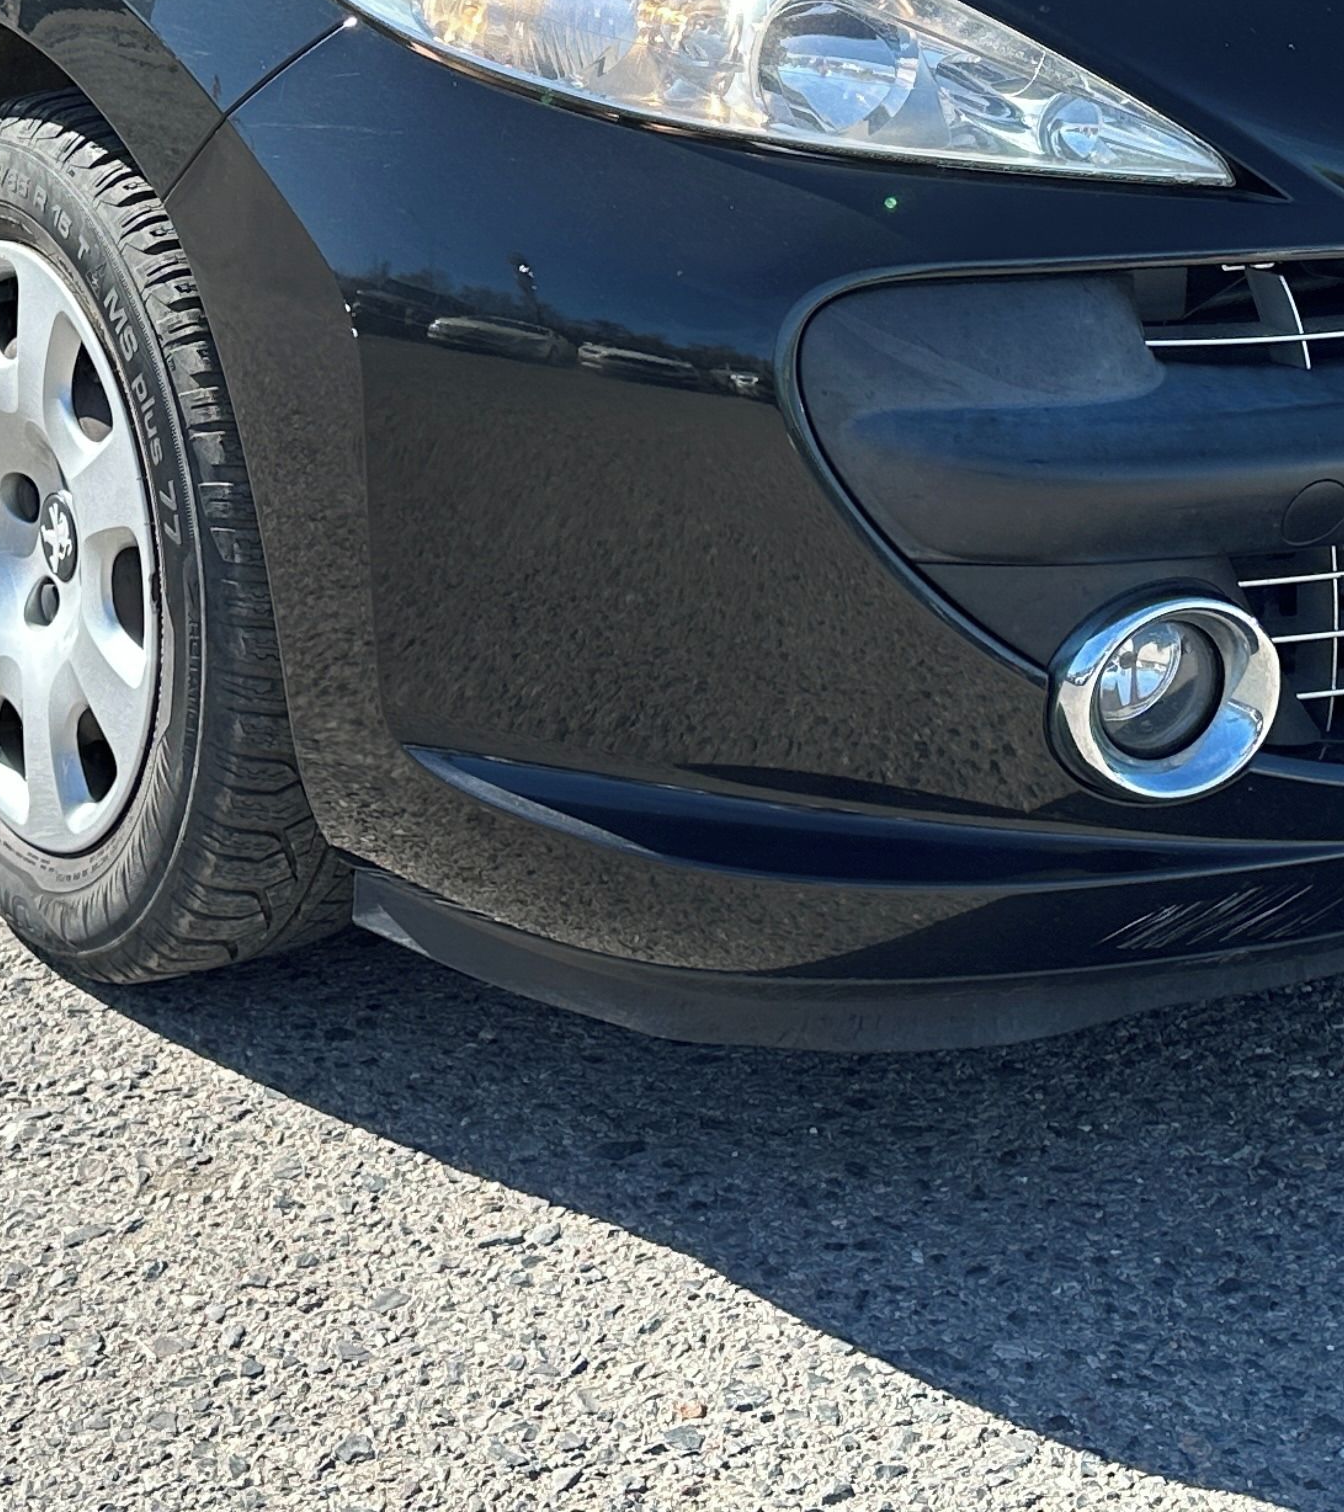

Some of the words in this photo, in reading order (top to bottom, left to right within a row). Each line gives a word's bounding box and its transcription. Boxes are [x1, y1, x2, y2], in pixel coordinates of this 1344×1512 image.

[103, 287, 138, 362] MS
[131, 372, 163, 466] plus
[159, 480, 182, 546] 77
